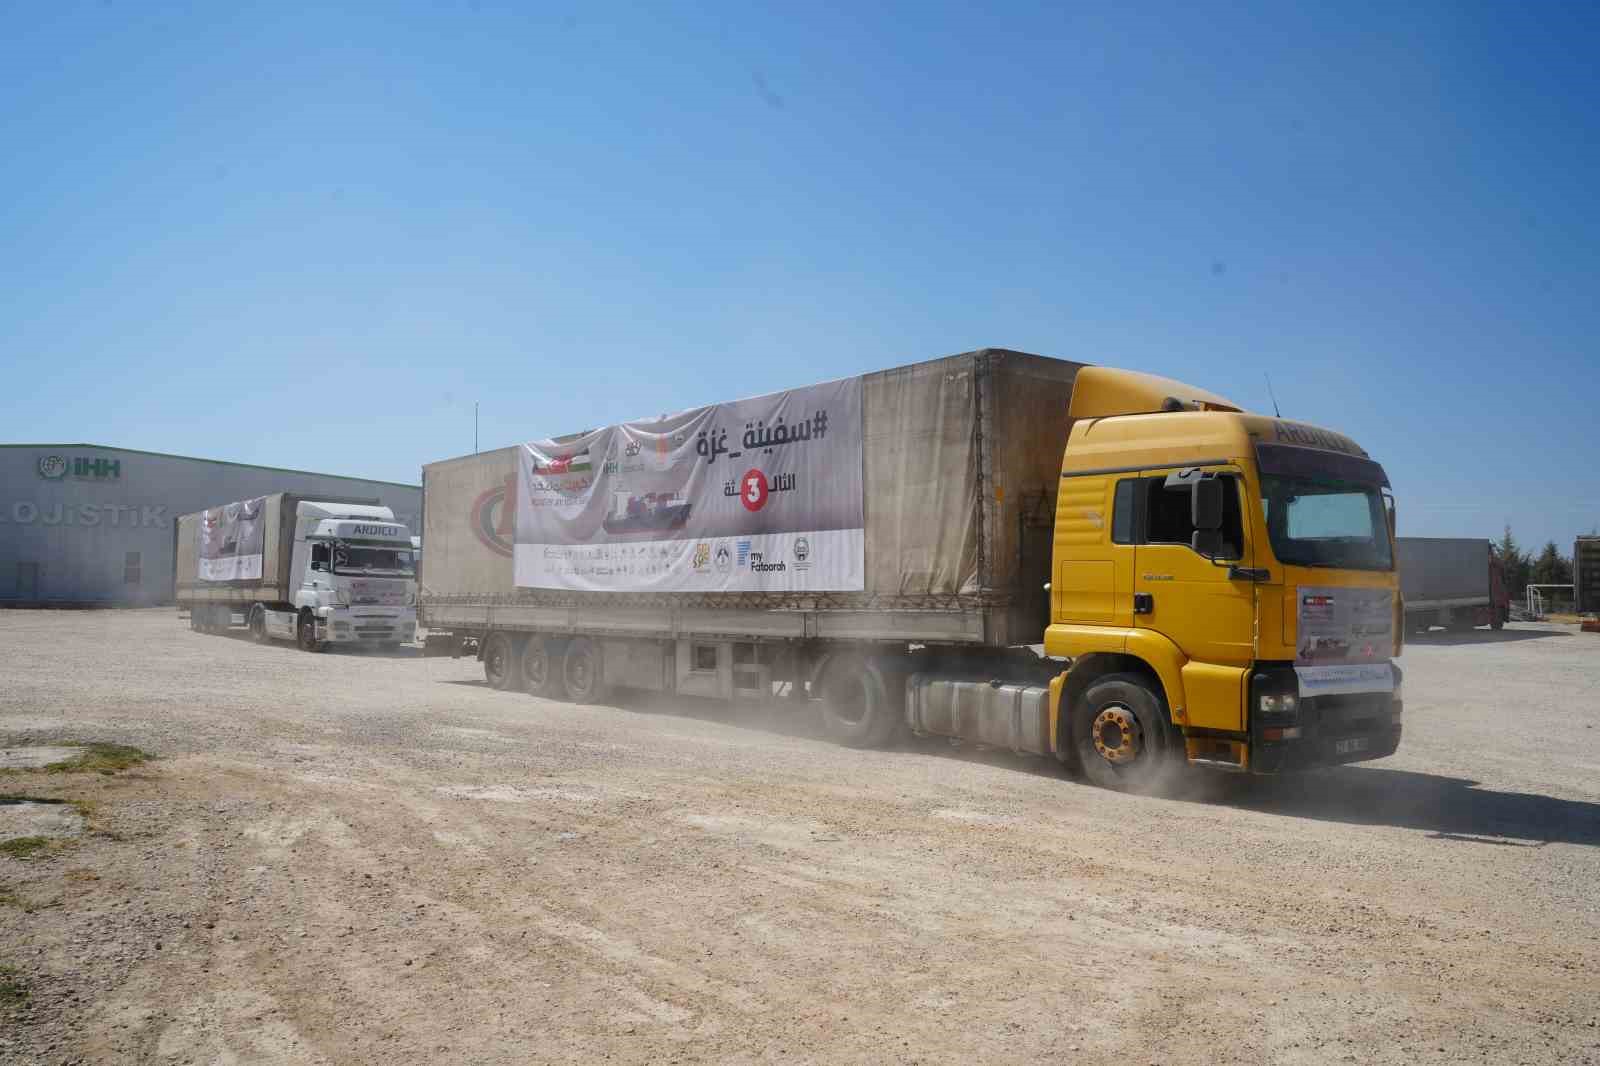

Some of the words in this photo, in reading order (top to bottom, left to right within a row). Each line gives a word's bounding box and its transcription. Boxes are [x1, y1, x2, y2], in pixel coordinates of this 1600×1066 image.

[696, 410, 827, 464] #سفينة_غزة
[747, 477, 761, 503] 3
[750, 552, 763, 563] my
[751, 560, 786, 572] Fatoorah
